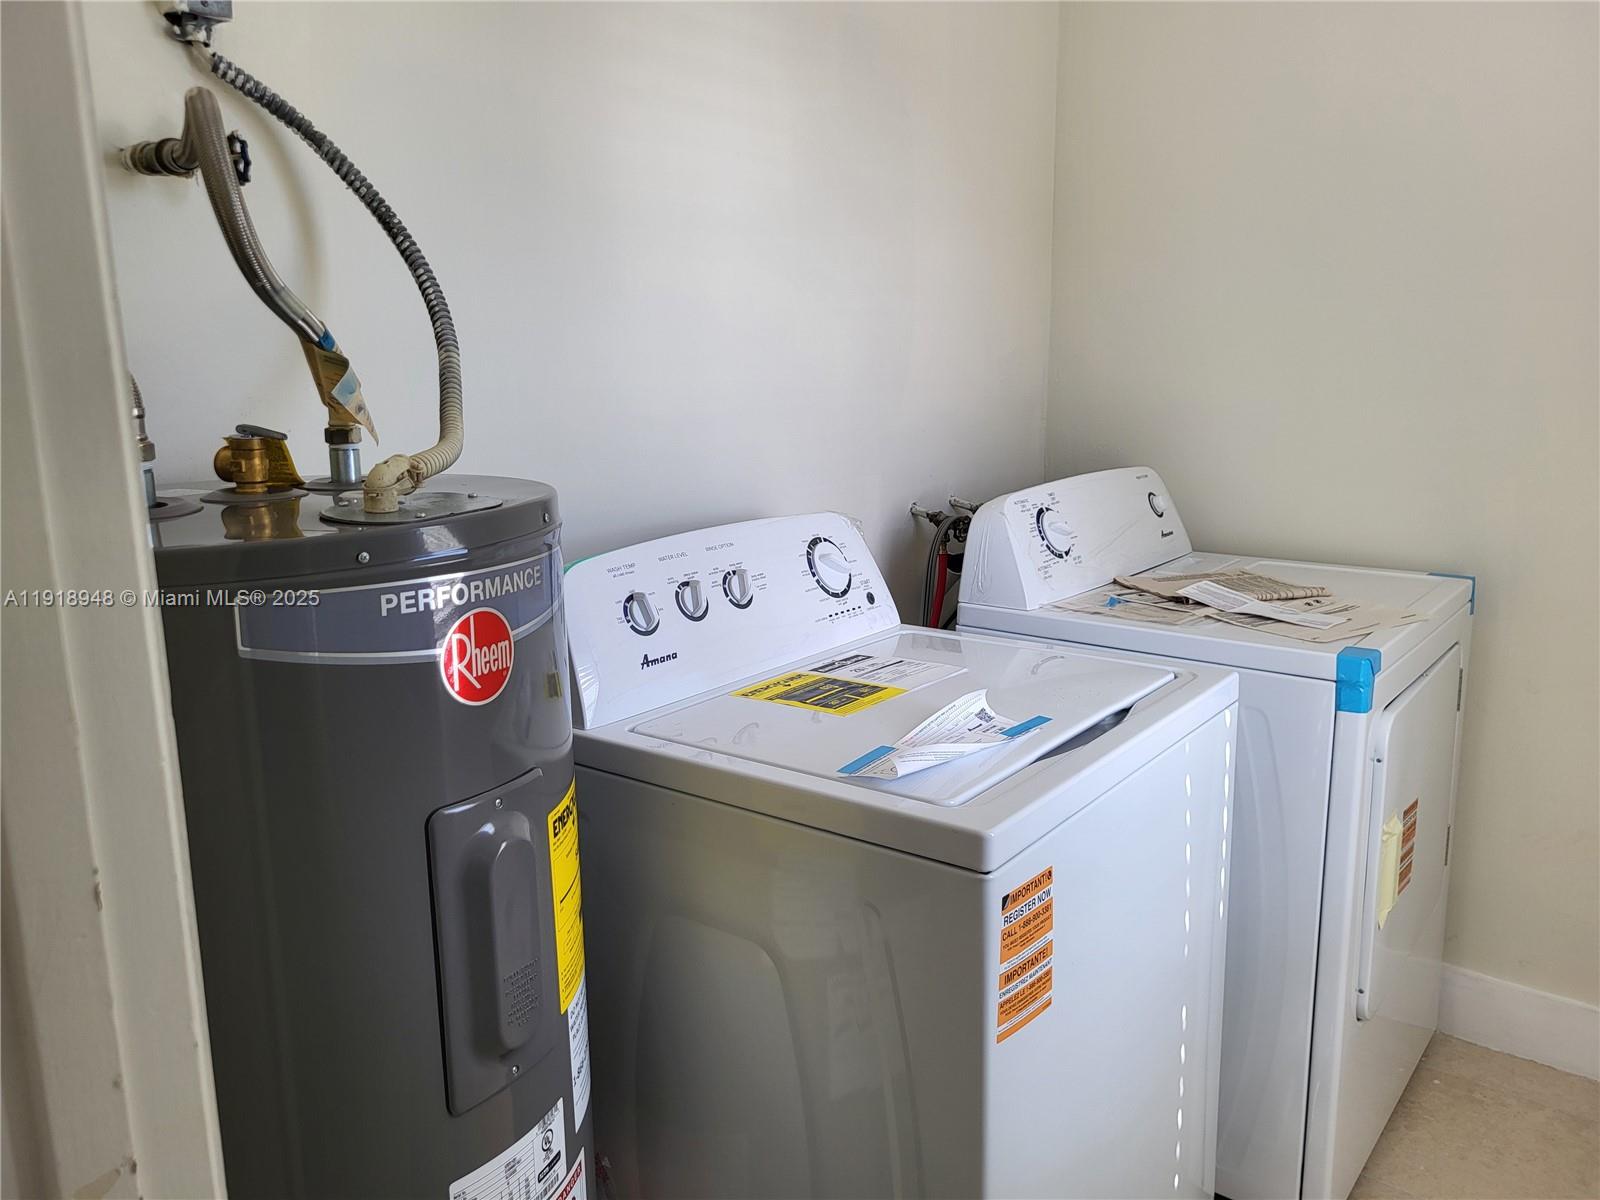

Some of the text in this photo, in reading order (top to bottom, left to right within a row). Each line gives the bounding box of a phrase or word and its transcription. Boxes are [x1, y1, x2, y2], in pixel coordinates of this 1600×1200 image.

[380, 565, 543, 617] PERFORMANCE
[451, 615, 511, 692] Rheem
[641, 652, 678, 670] Amana
[1003, 887, 1051, 927] REGISTER NOW
[1003, 927, 1017, 942] CALL
